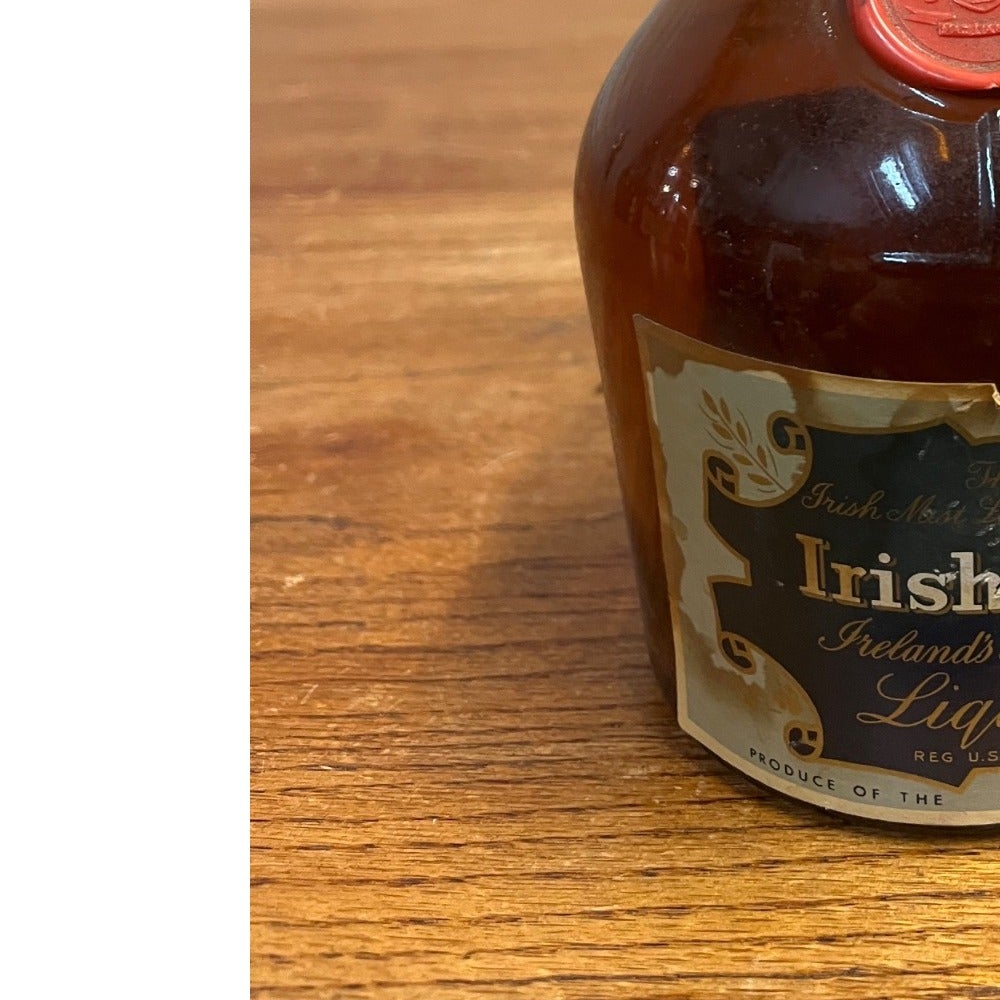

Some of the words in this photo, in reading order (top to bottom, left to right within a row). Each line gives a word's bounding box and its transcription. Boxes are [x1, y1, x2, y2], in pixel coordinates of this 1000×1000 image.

[802, 483, 882, 521] Irish
[818, 617, 994, 666] Ireland's
[749, 747, 836, 791] PRODUCE
[853, 785, 882, 800] OF
[900, 792, 944, 806] THE
[914, 750, 954, 763] REG
